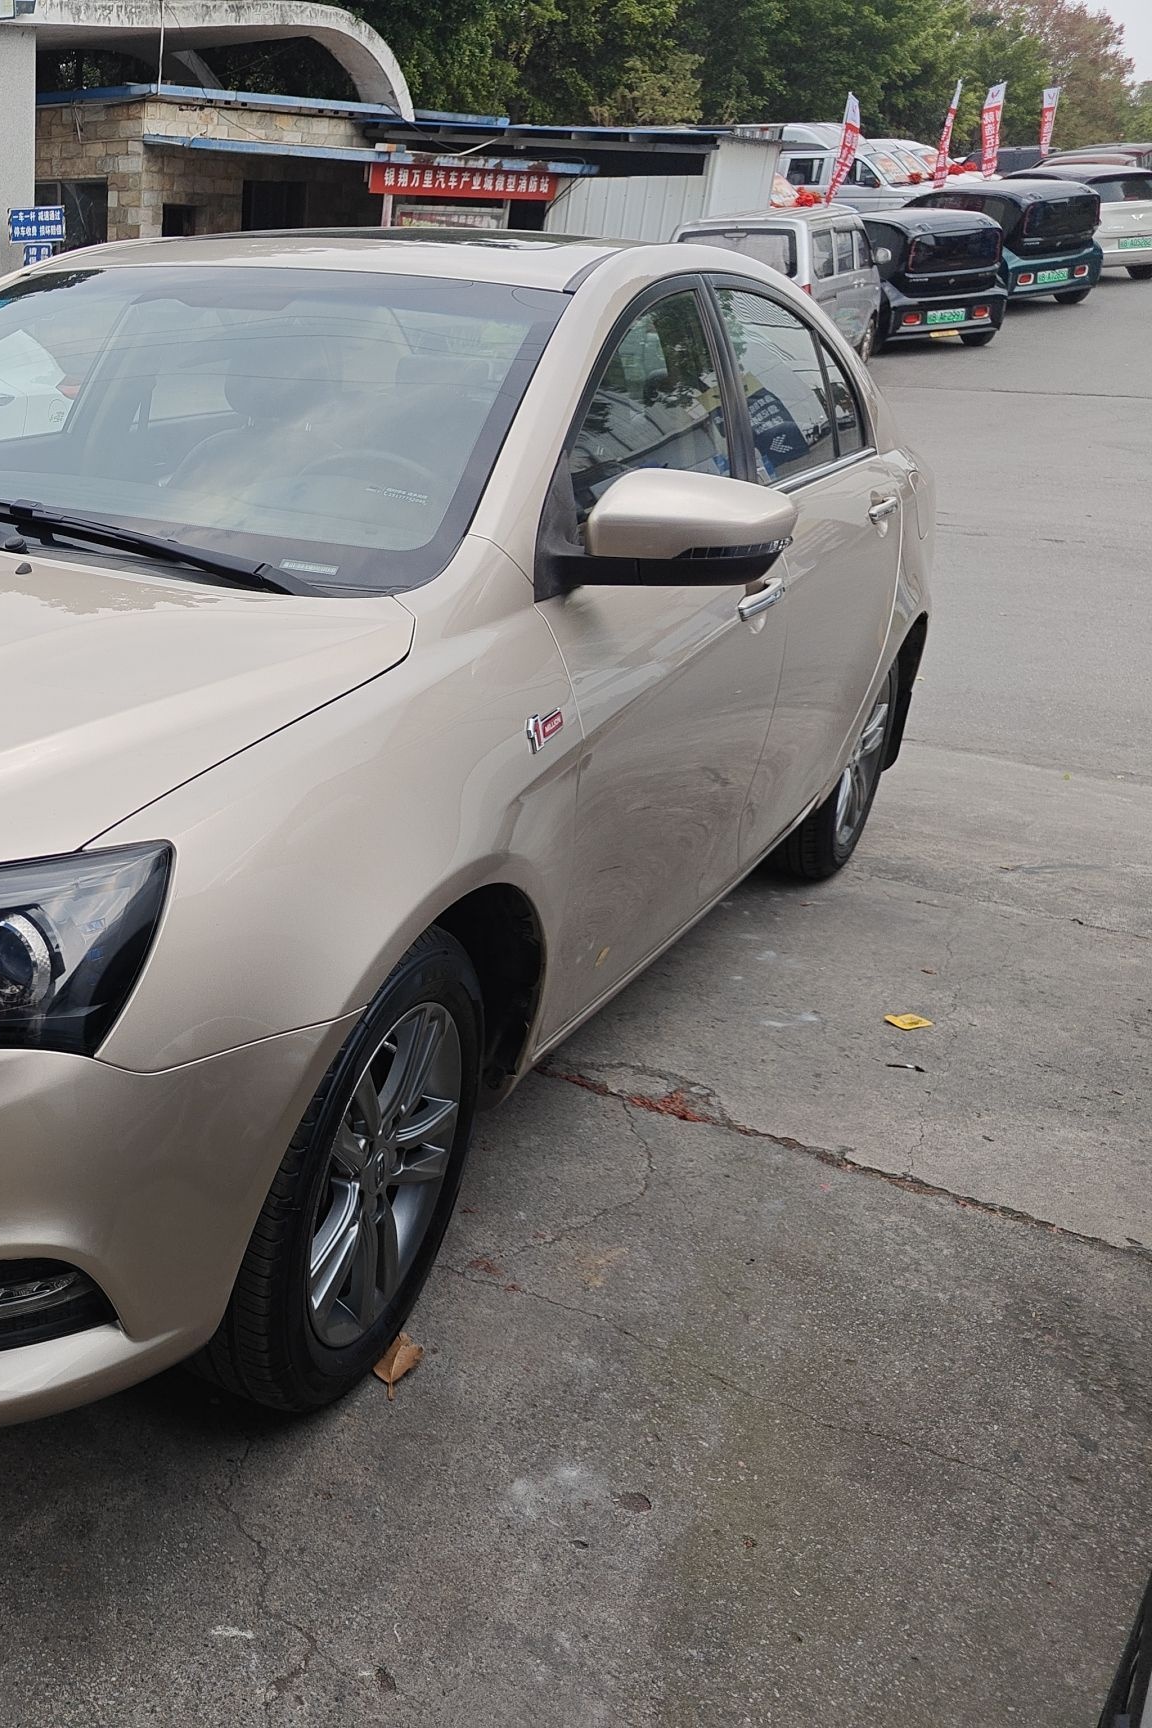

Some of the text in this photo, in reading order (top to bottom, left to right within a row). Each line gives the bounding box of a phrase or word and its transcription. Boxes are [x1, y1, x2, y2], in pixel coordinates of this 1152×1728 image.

[384, 167, 550, 194] 银翔万里汽车产业城微型消防站
